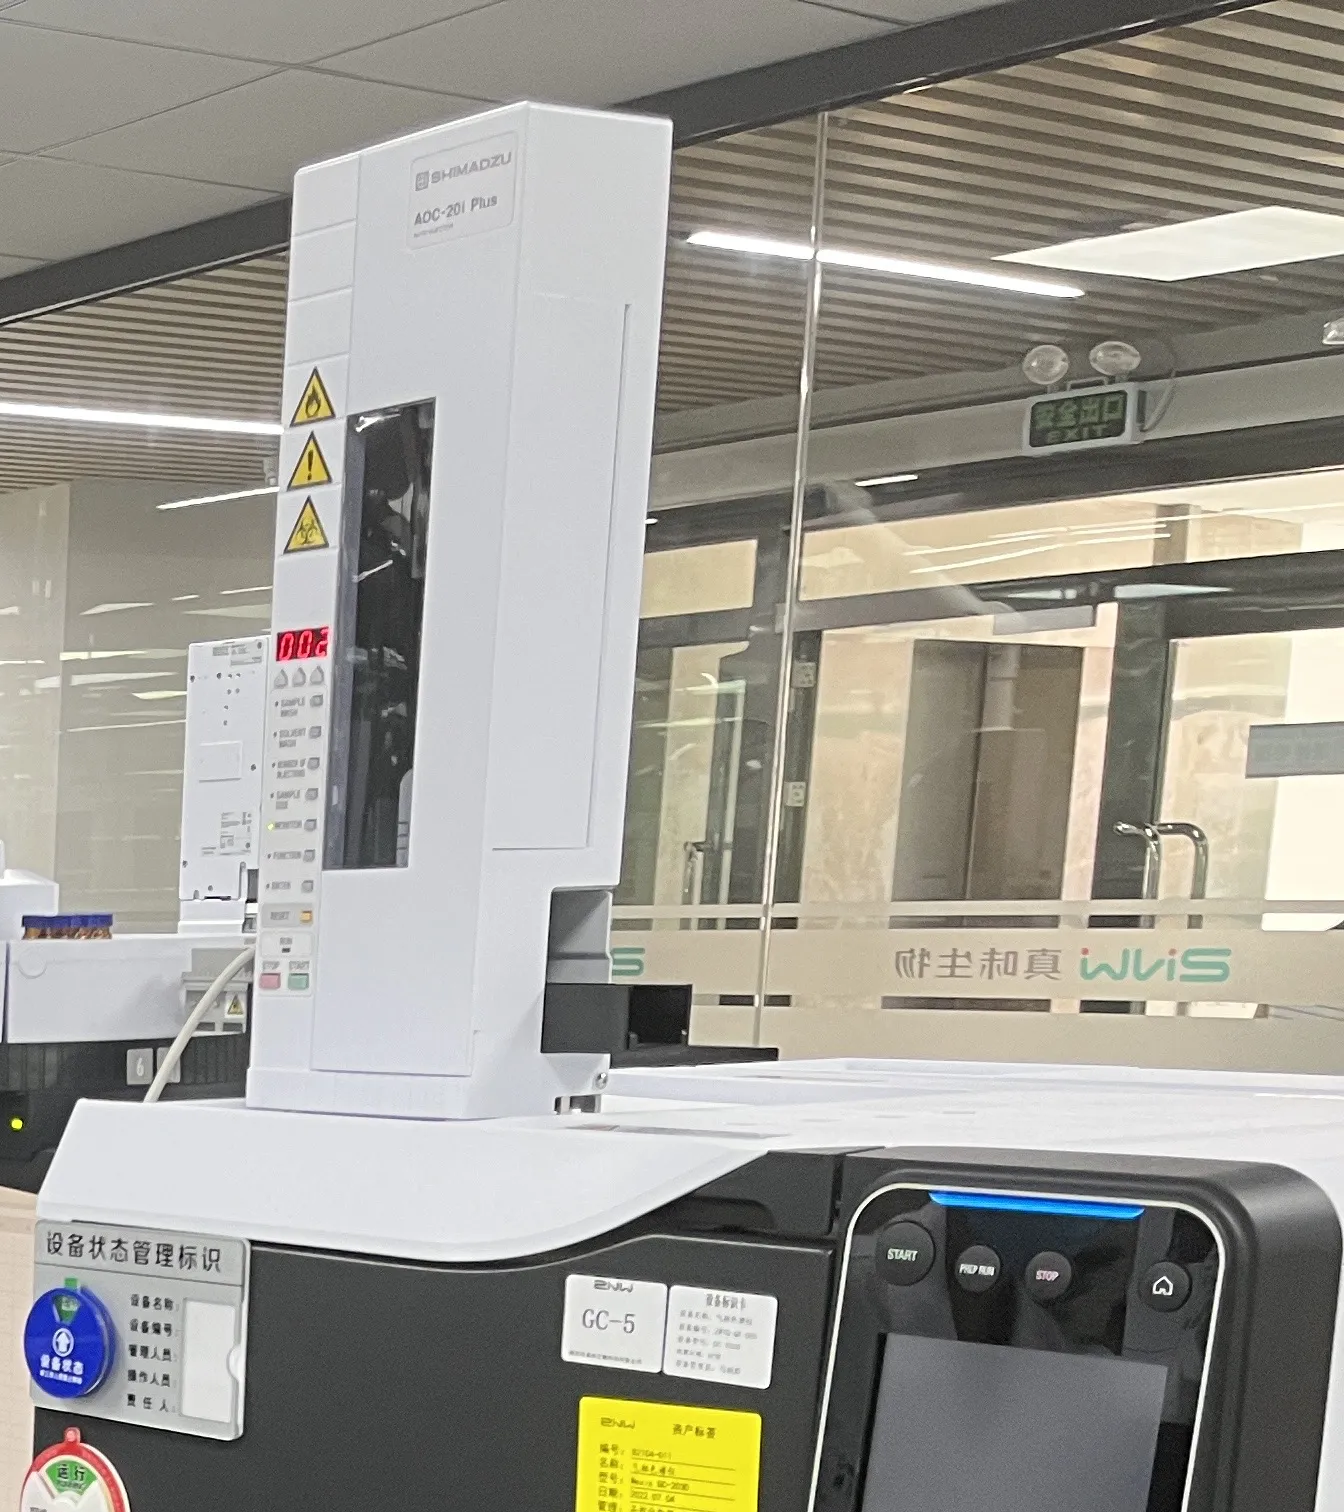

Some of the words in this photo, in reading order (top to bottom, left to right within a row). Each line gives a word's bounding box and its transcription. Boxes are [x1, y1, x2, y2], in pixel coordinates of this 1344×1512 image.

[431, 152, 512, 184] SHIMADZU
[471, 196, 498, 212] Plus
[1048, 424, 1109, 444] EXIT
[280, 627, 329, 661] 002
[136, 1057, 145, 1077] 6
[46, 1231, 222, 1273] 设备状态管理标识
[887, 1247, 918, 1263] START
[1035, 1269, 1060, 1282] STOP
[582, 1308, 636, 1335] GC-5
